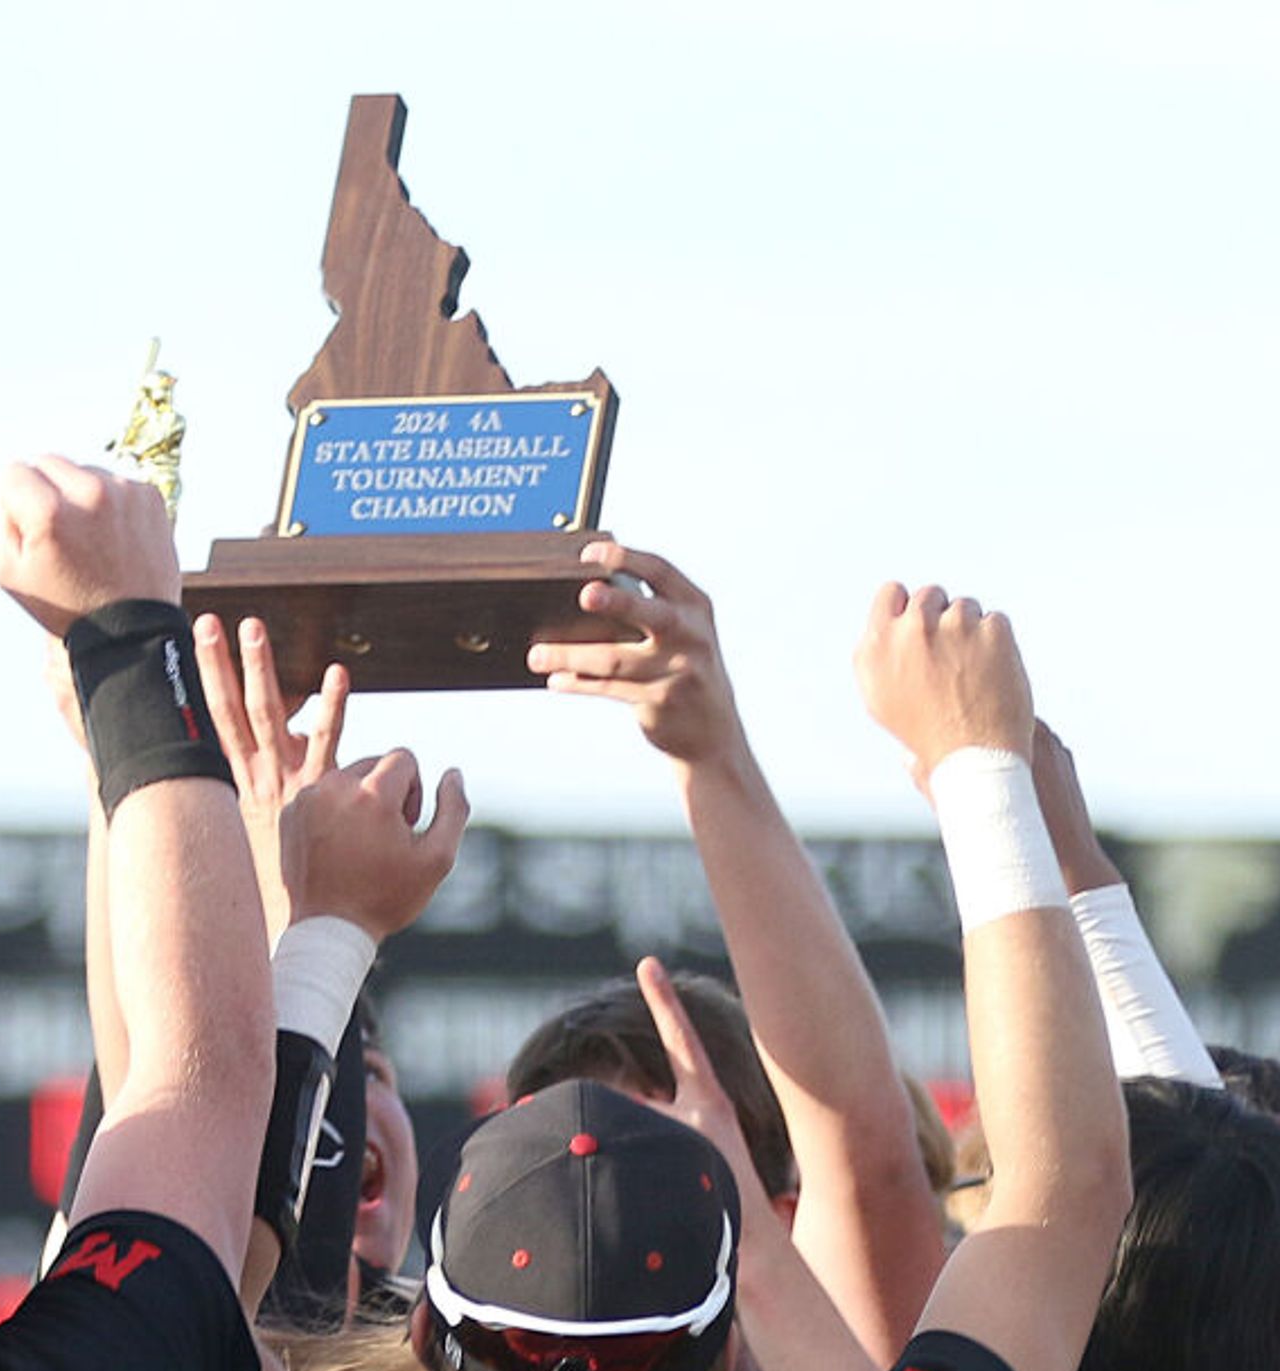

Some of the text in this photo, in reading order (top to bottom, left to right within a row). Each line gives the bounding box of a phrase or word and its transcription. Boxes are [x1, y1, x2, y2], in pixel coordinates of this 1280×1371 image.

[392, 410, 502, 434] 2024 4A
[314, 435, 571, 464] STATE BASEBALL
[331, 464, 548, 491] TOURNAMENT
[350, 494, 516, 520] CHAMPION
